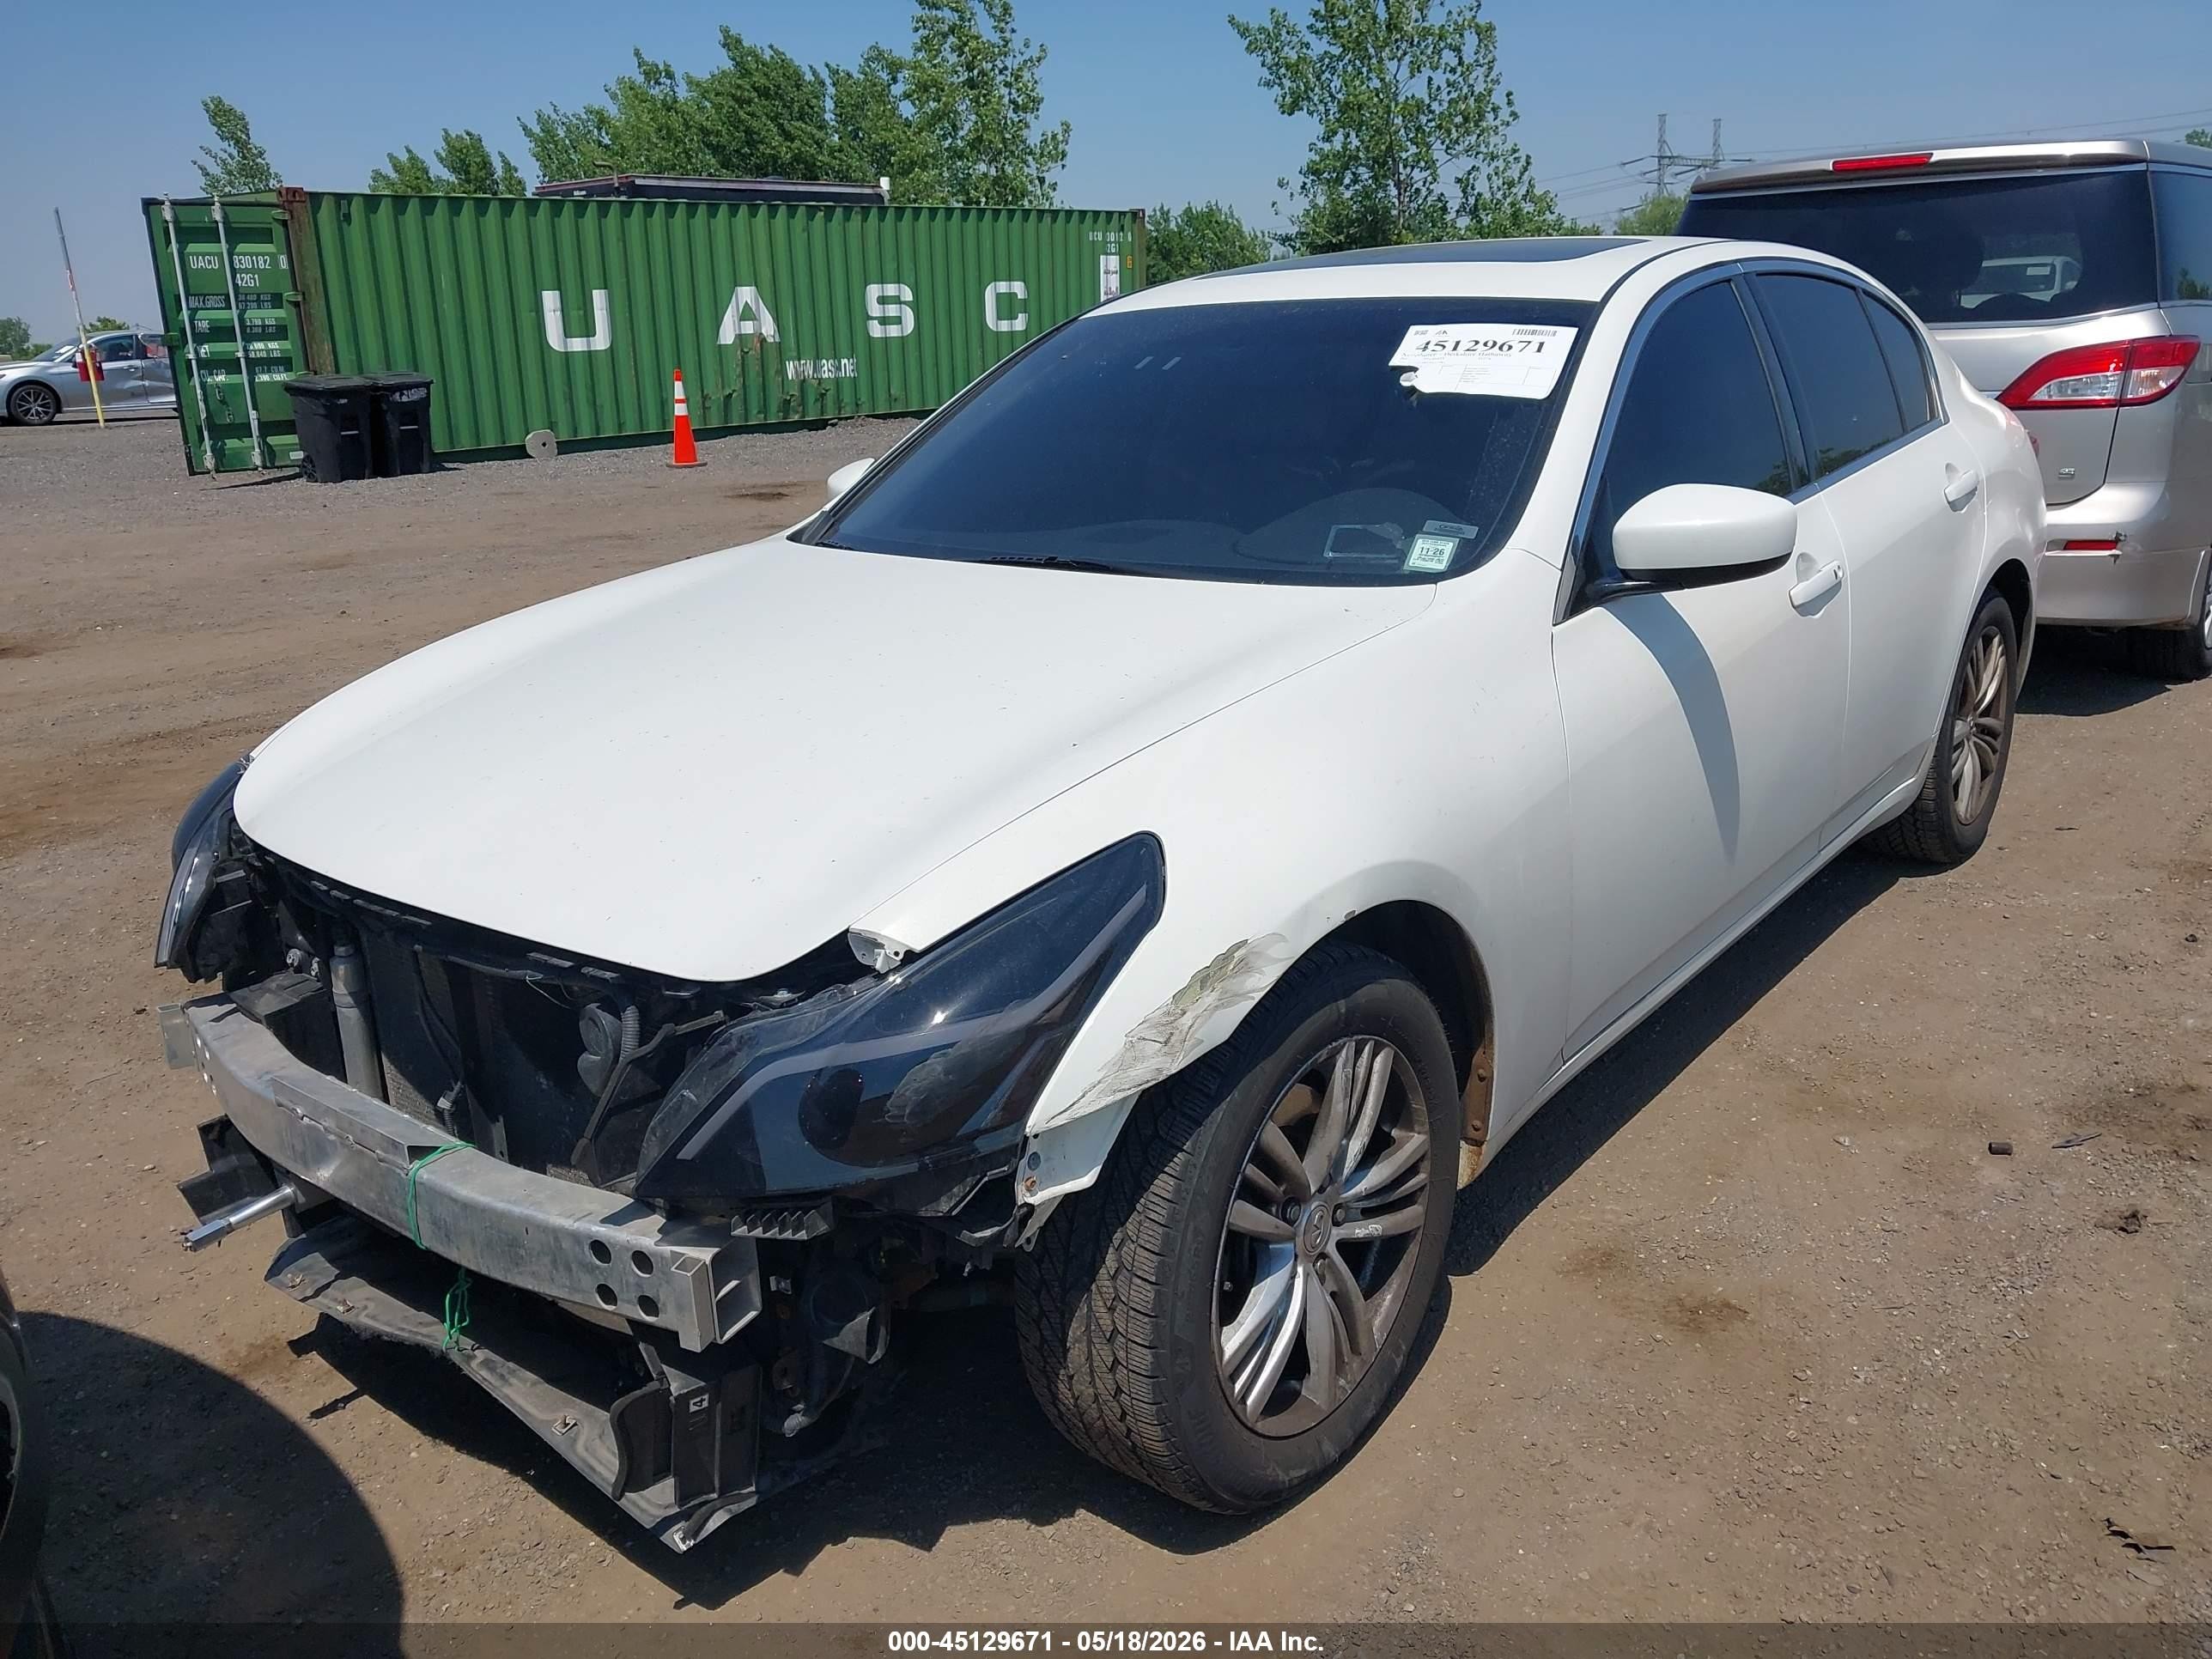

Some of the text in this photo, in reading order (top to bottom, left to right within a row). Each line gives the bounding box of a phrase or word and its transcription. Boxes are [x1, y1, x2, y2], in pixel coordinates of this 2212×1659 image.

[1106, 244, 1119, 253] 2G1
[189, 256, 219, 269] UACU
[233, 255, 271, 269] 830182
[235, 274, 259, 288] 42G1
[194, 320, 210, 333] TARE
[1414, 339, 1546, 354] 45129671
[786, 354, 858, 380] www.uasc.net
[1419, 545, 1446, 556] 11-26
